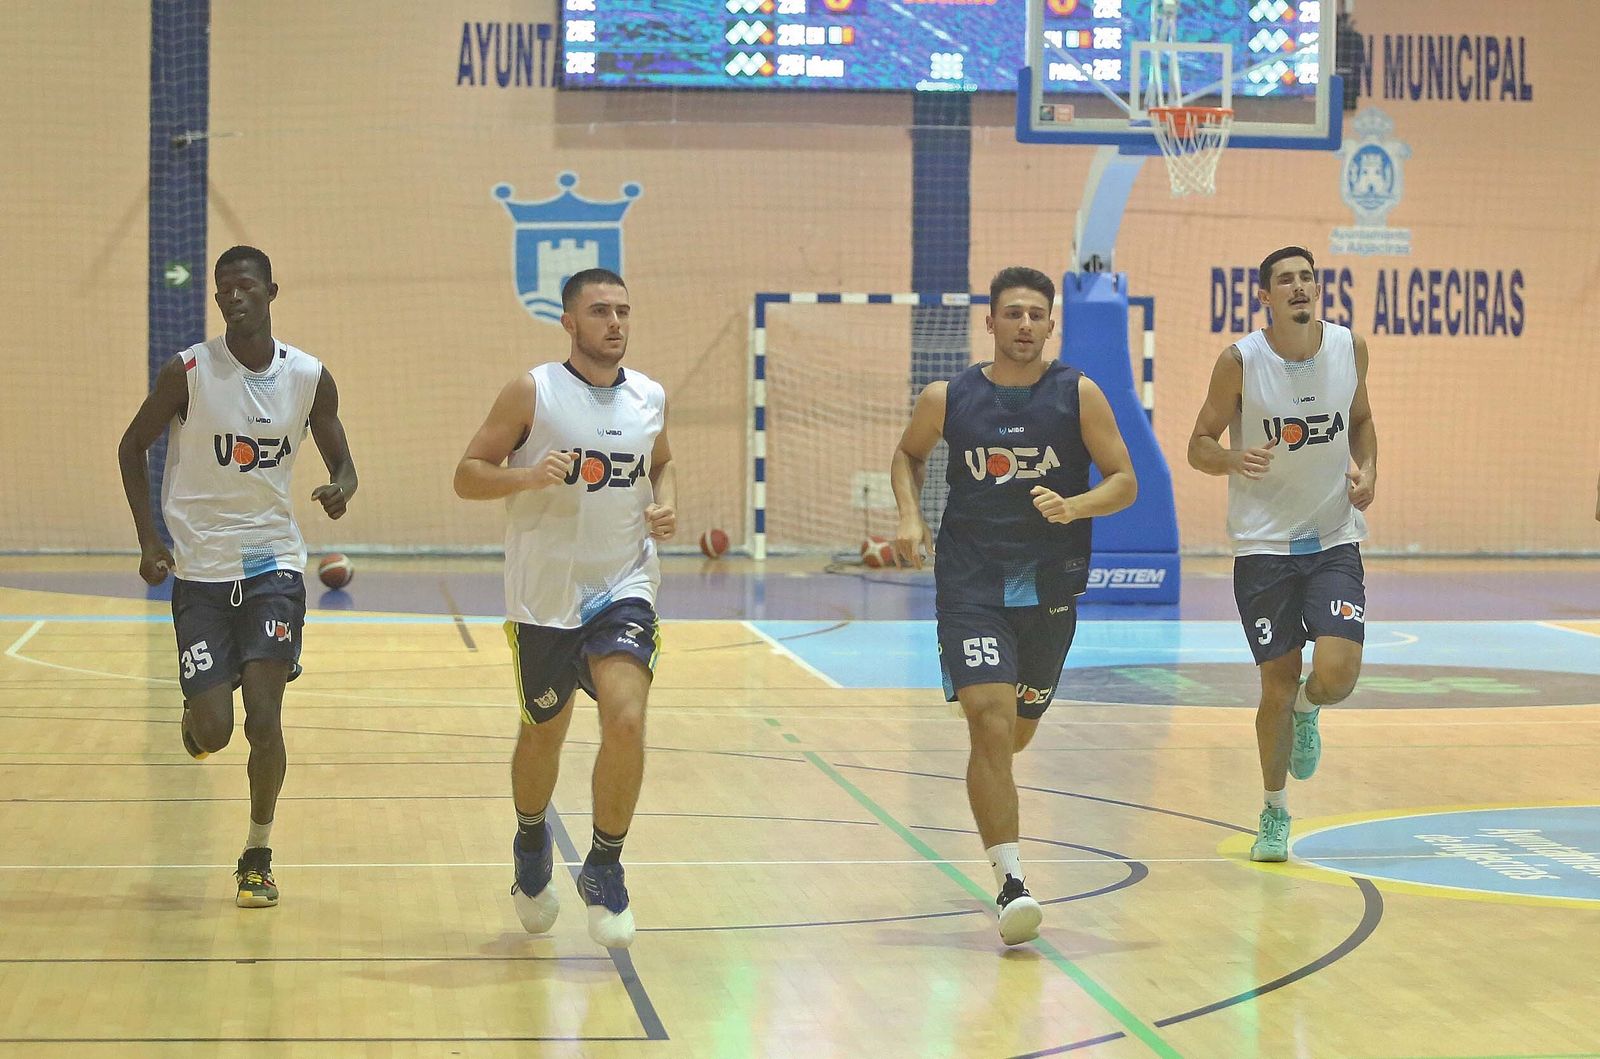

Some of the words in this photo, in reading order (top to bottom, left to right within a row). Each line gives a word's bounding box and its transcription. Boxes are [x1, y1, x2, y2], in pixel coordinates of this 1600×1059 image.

[1383, 34, 1533, 101] MUNICIPAL
[1210, 266, 1354, 334] DEPES
[1374, 268, 1525, 336] ALGECIRAS
[1263, 411, 1344, 452] UDEA
[214, 433, 291, 473] UDEA
[964, 445, 1061, 485] UDEA
[1255, 617, 1273, 646] 3
[181, 640, 214, 680] 35
[962, 637, 1001, 668] 55
